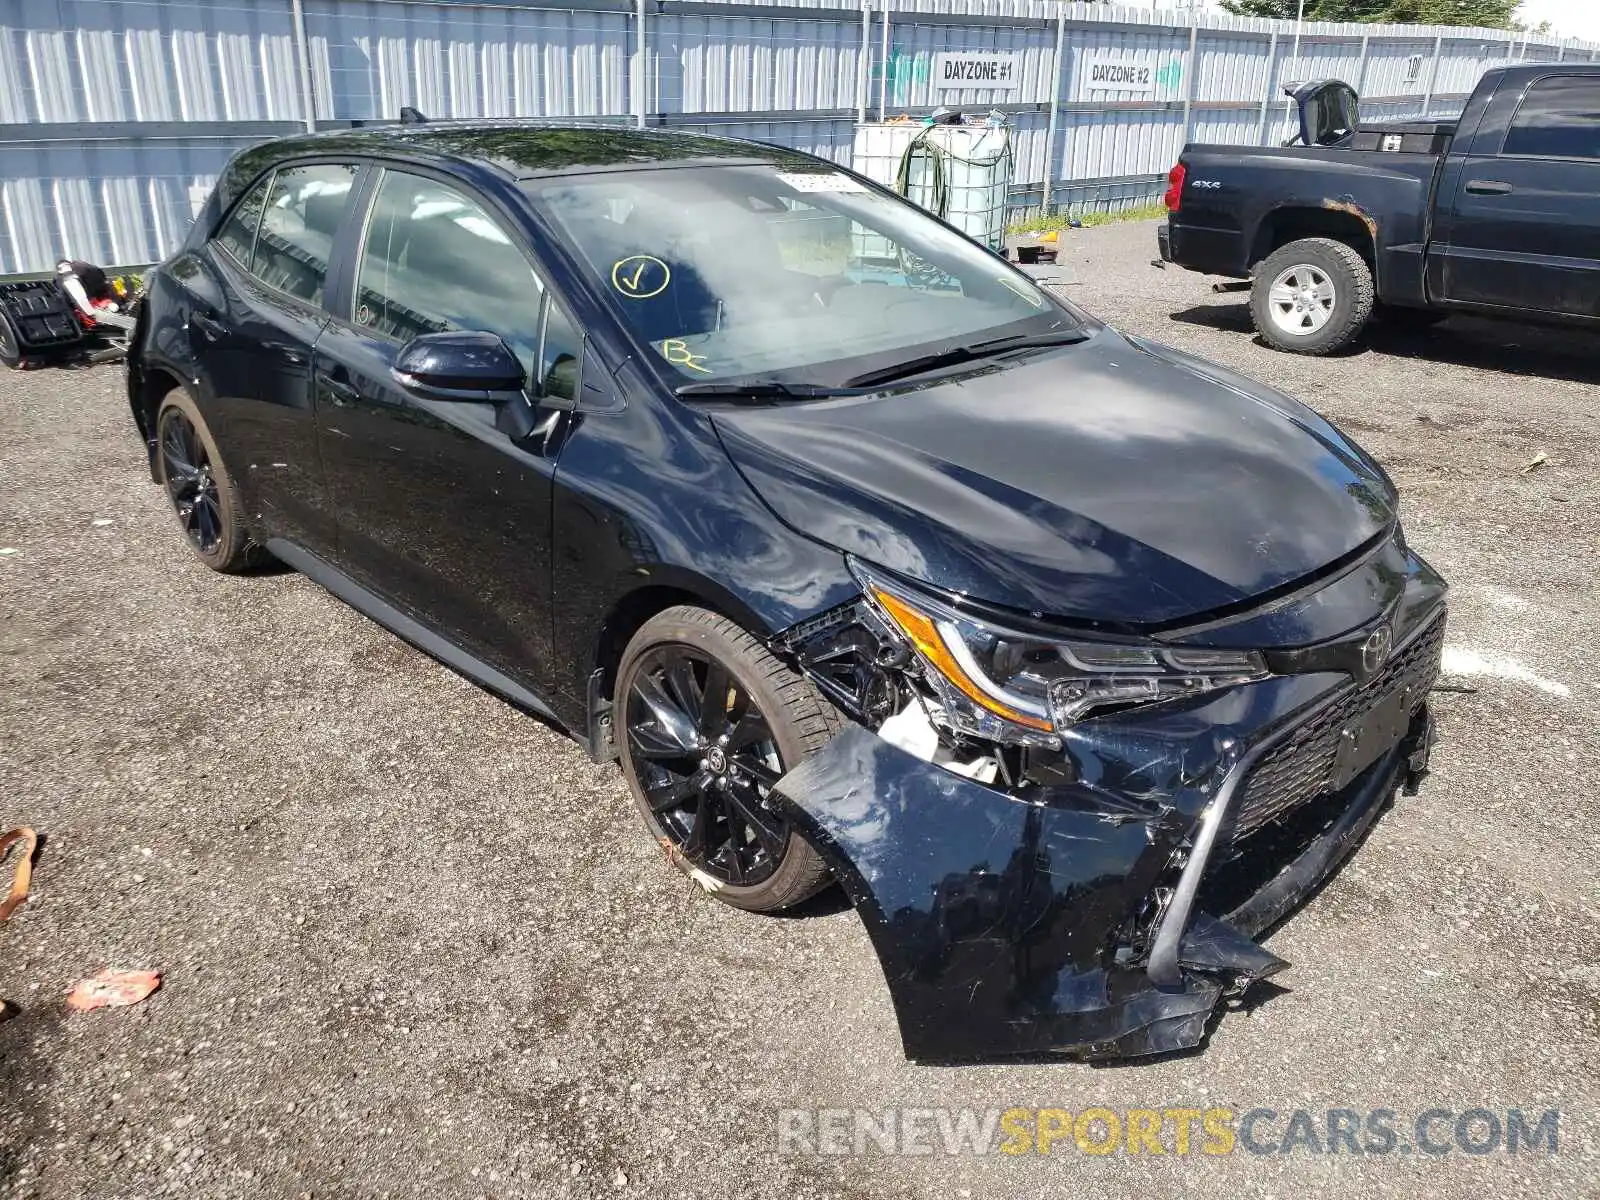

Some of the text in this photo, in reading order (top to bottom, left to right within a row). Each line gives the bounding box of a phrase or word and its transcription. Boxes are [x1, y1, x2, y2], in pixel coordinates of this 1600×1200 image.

[944, 60, 1012, 80] DAYZONE #1
[1092, 64, 1149, 84] DAYZONE #2
